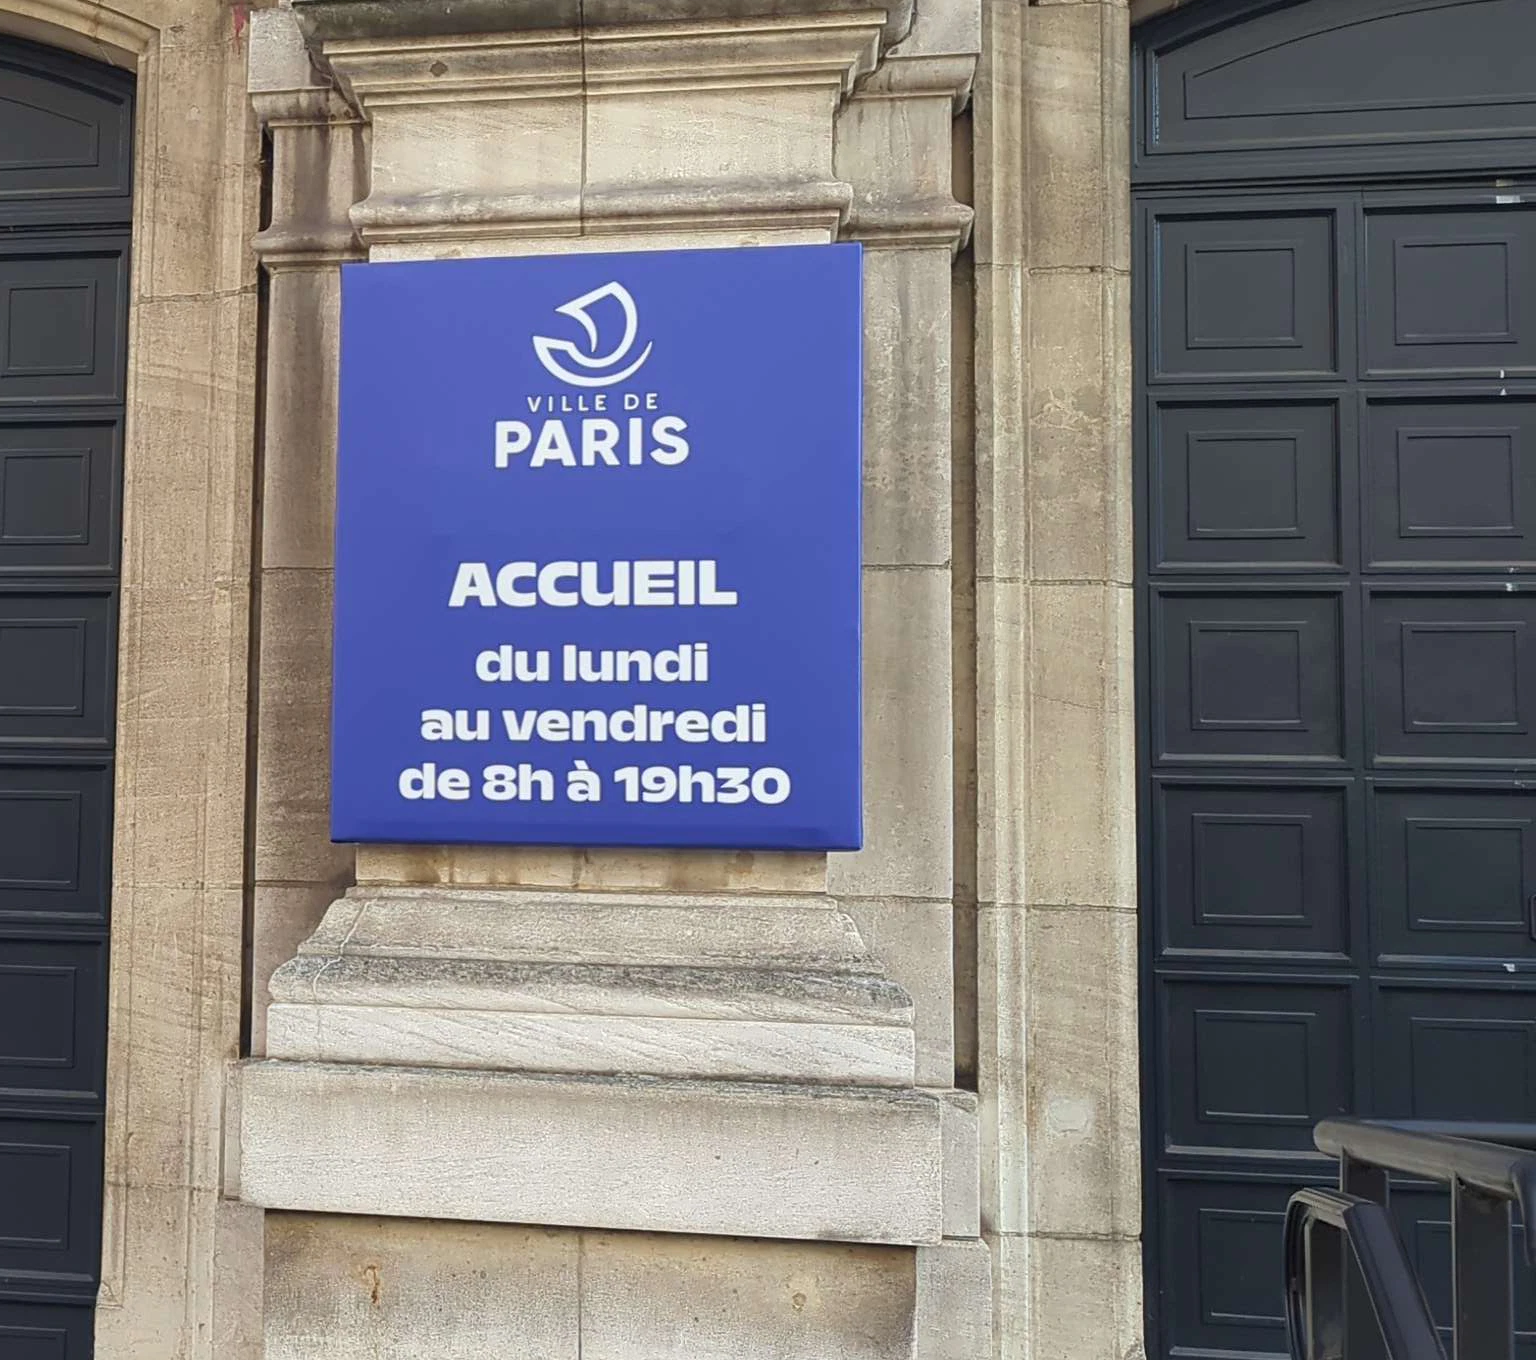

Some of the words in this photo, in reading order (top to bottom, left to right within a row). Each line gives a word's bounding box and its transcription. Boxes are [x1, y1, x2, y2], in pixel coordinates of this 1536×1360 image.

[527, 393, 607, 413] VILLE
[624, 392, 659, 410] DE
[494, 415, 690, 469] PARIS
[448, 559, 739, 608] ACCUEIL
[474, 644, 550, 683] du
[562, 642, 709, 683] lundi
[420, 709, 491, 742] au
[501, 703, 767, 744] vendredi
[398, 762, 472, 802] de
[481, 762, 555, 803] 8h
[566, 760, 602, 803] à
[613, 765, 792, 806] 19h30
